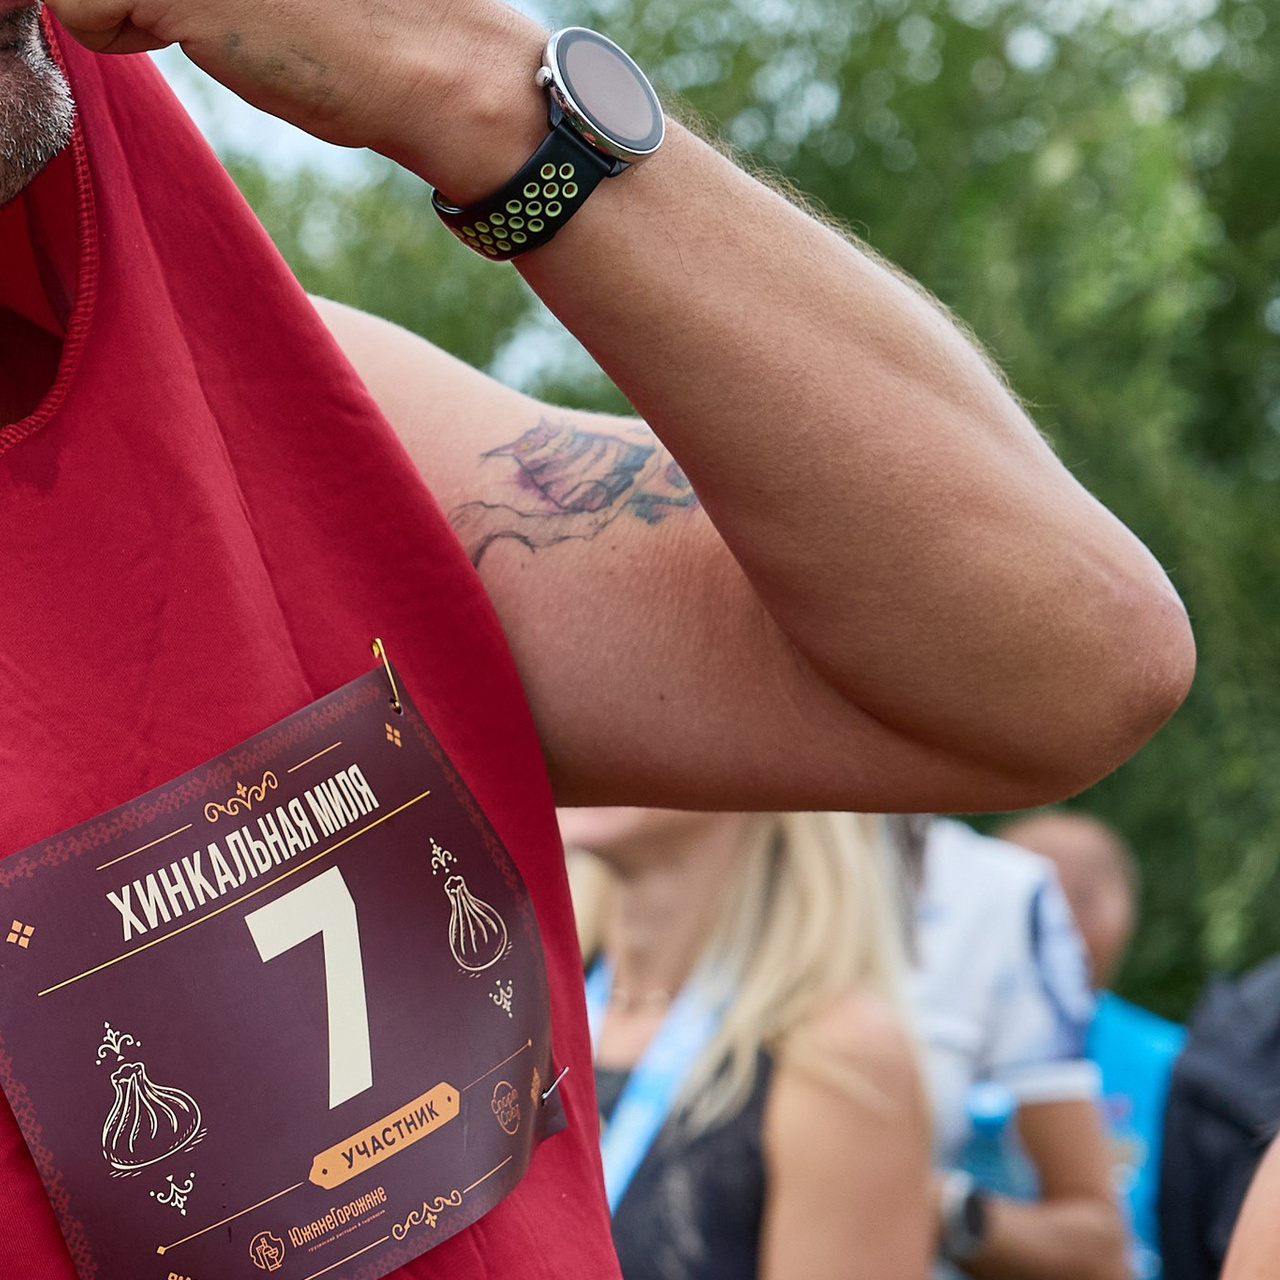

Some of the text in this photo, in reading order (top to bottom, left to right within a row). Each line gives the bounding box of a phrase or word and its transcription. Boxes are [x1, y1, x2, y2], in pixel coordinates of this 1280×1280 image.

[106, 763, 380, 942] ХИНКАЛЬНАЯ МИЛЯ
[244, 865, 373, 1110] 7
[341, 1100, 439, 1169] УЧАСТНИК
